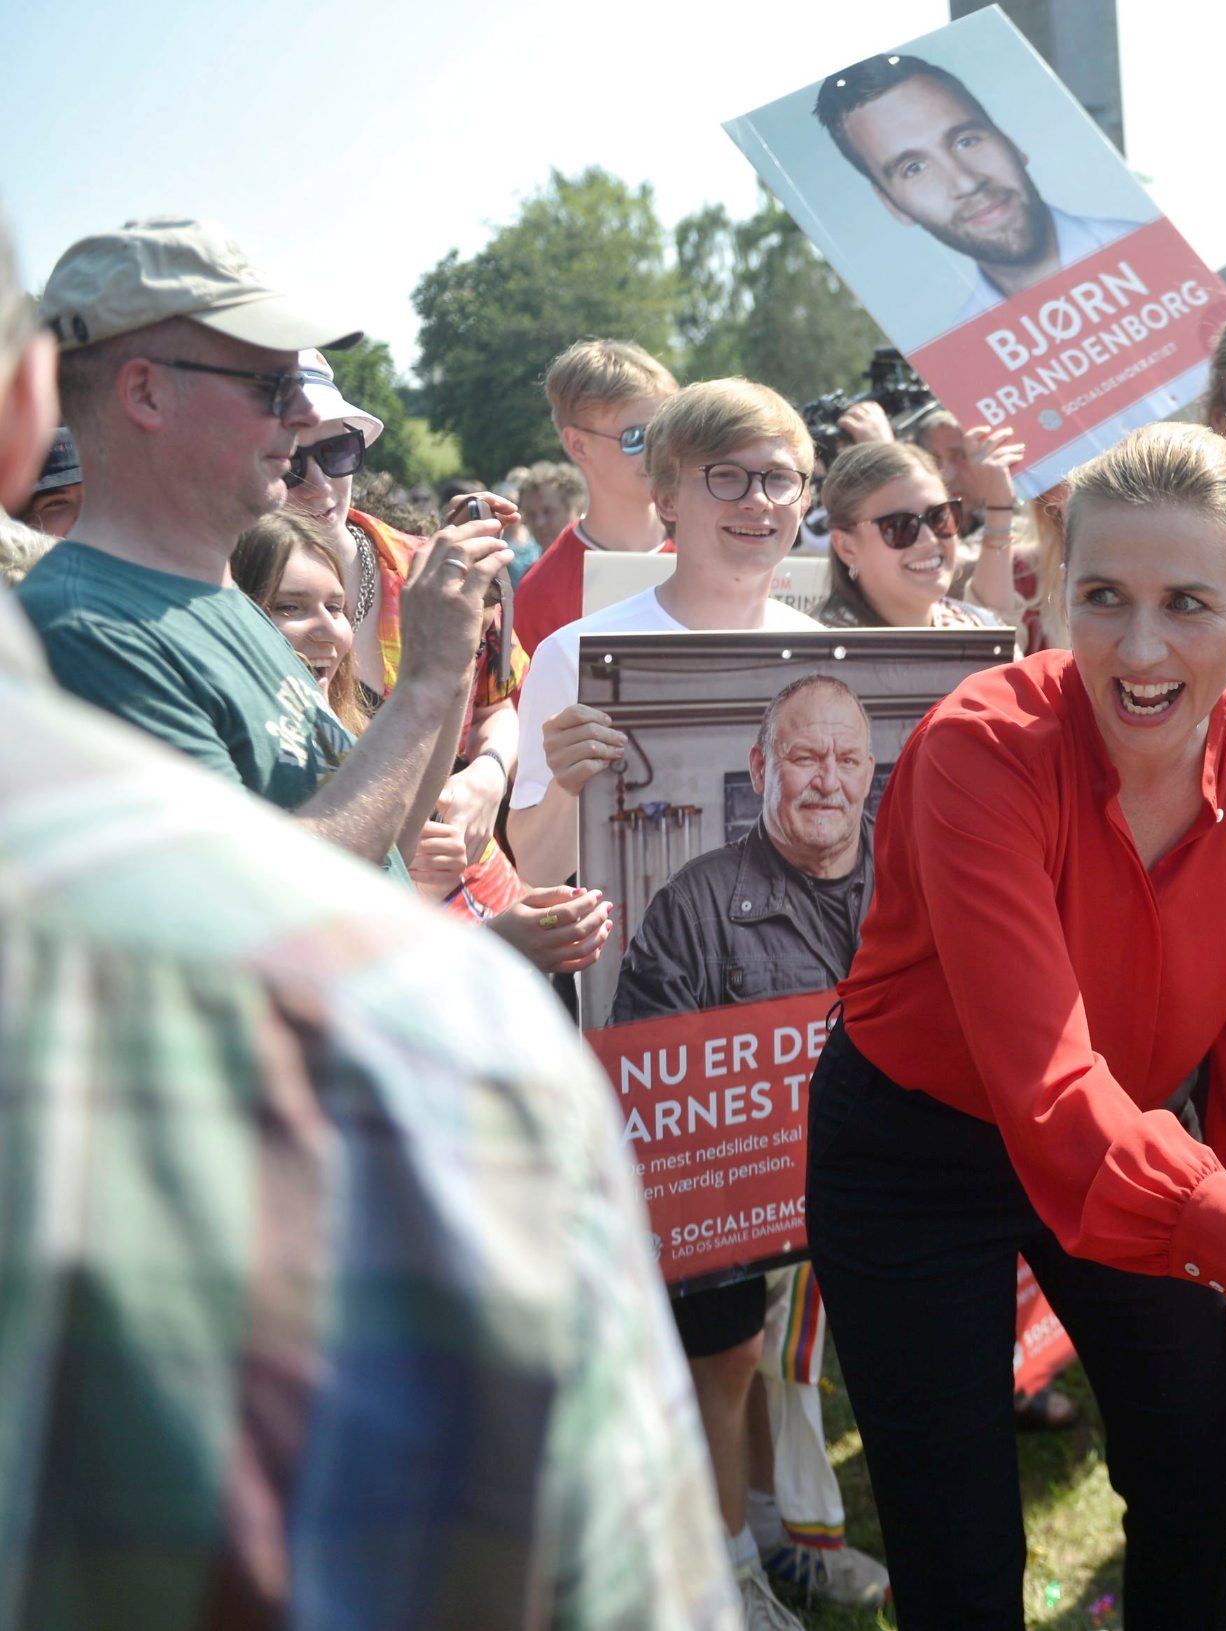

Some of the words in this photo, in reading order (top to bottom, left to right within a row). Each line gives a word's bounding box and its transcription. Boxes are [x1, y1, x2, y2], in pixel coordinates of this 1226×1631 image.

[985, 261, 1149, 372] BJØRN
[976, 280, 1209, 426] BRANDENBORG
[1061, 342, 1177, 415] SOCIALDEMOKRATIET
[620, 1044, 688, 1095] NU
[704, 1034, 758, 1078] ER
[619, 1081, 773, 1143] ARNES
[783, 1072, 815, 1112] T
[651, 1150, 691, 1173] mest
[696, 1134, 769, 1162] nedslidte
[772, 1124, 803, 1147] skal
[668, 1167, 724, 1194] værdig
[728, 1154, 795, 1184] pension.
[672, 1245, 695, 1260] LAD
[696, 1239, 712, 1254] OS
[714, 1228, 750, 1249] SAMLE
